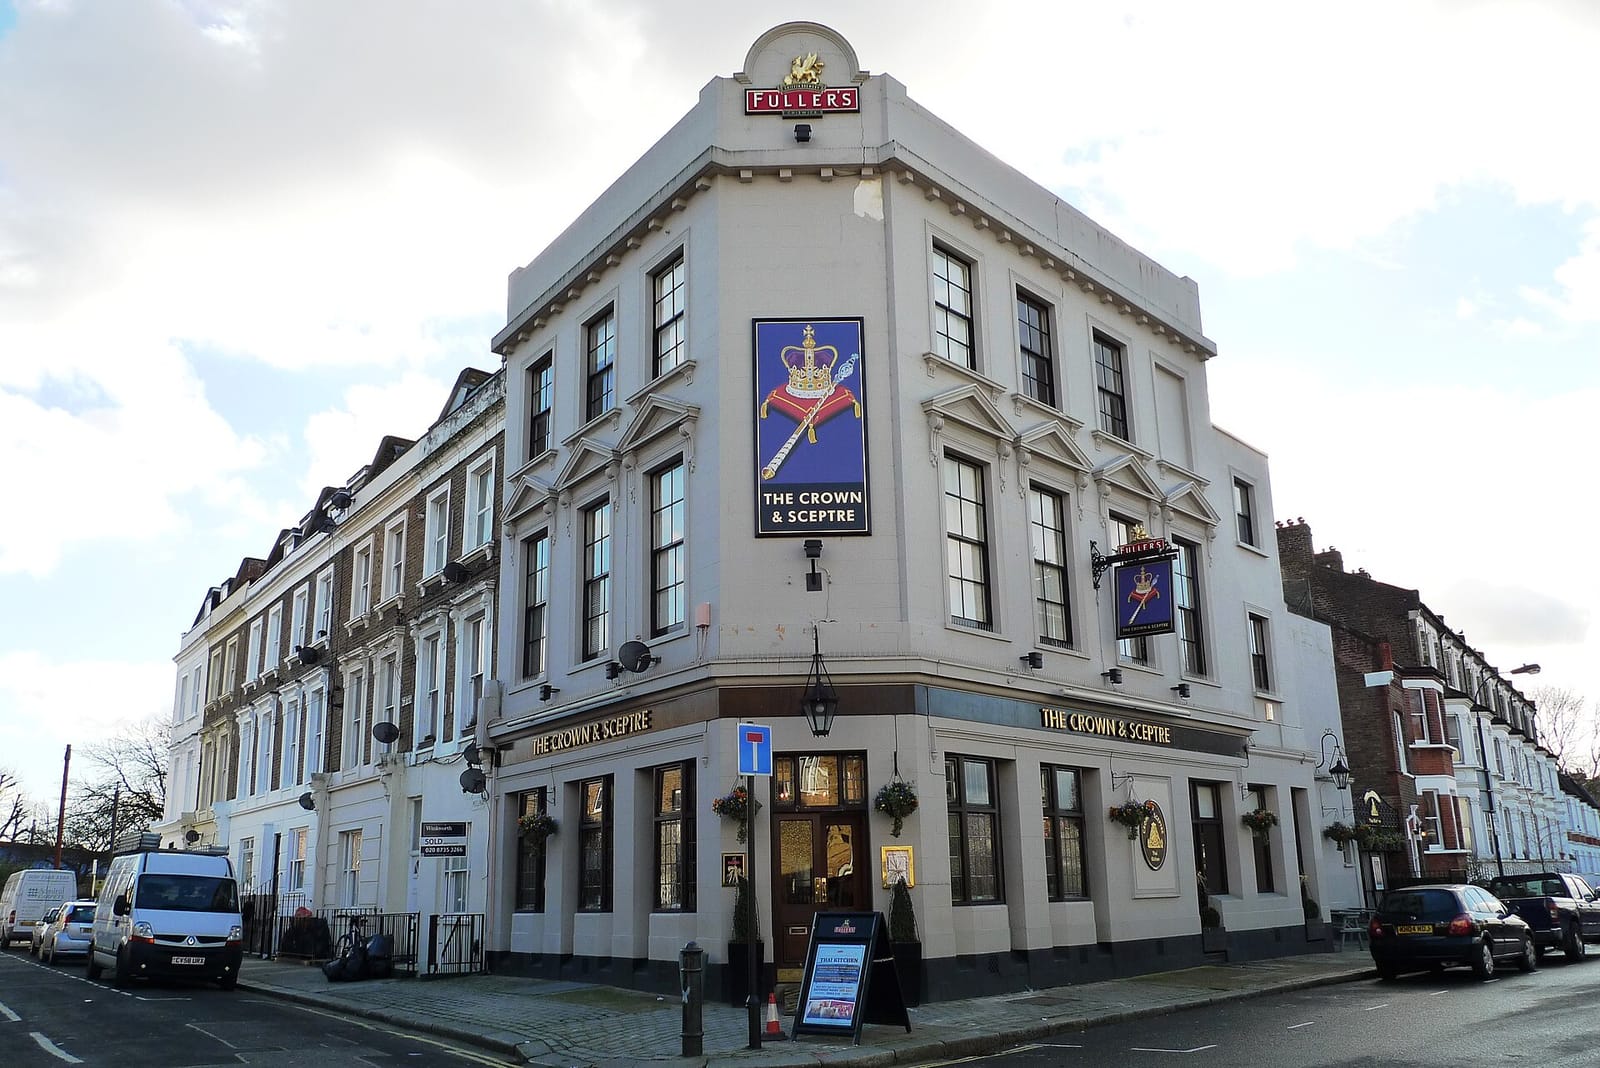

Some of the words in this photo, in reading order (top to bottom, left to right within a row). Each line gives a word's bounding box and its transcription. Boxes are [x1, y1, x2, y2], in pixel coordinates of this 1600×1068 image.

[753, 89, 852, 108] FULLER'S
[763, 493, 794, 505] THE
[799, 491, 862, 505] CROWN
[772, 511, 783, 523] &
[788, 509, 855, 523] SCEPTRE
[533, 736, 550, 756] THE
[551, 725, 590, 750] CROWN
[592, 723, 601, 741] &
[603, 709, 650, 738] SCEPTRE
[1041, 708, 1066, 729] THE
[1069, 713, 1116, 736] CROWN
[1118, 720, 1127, 738] &
[1129, 722, 1171, 743] SCEPTRE
